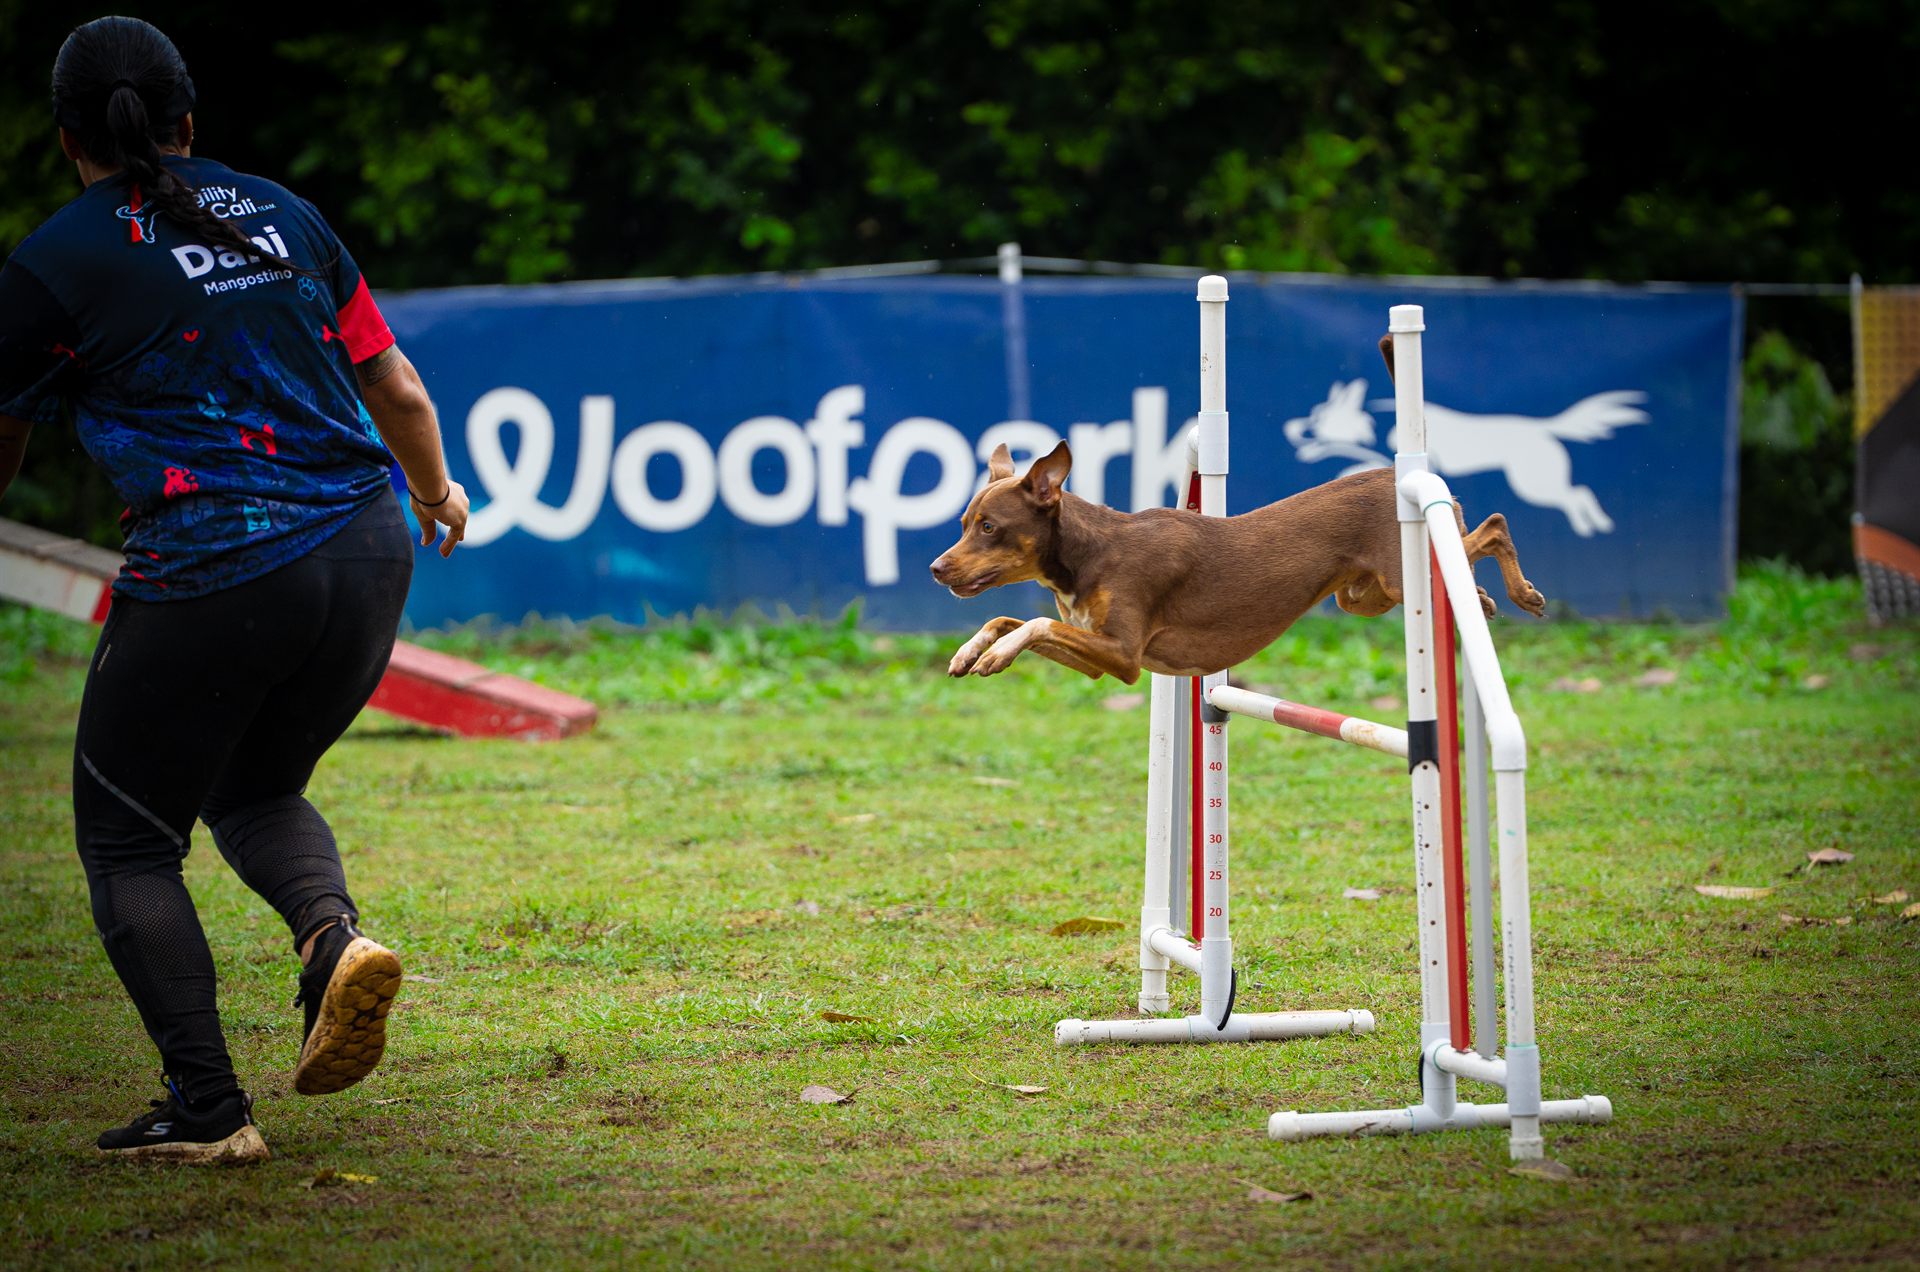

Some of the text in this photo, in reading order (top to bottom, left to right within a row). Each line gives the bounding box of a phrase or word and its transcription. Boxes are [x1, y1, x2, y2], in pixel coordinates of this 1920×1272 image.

[189, 186, 236, 208] gility
[210, 197, 276, 219] Cali TEAM
[203, 269, 292, 296] Mangostino
[1209, 725, 1222, 735] 45
[1209, 761, 1222, 771] 40
[1209, 798, 1222, 808] 35
[1209, 834, 1222, 844] 30
[1209, 870, 1222, 880] 25
[1209, 907, 1222, 917] 20
